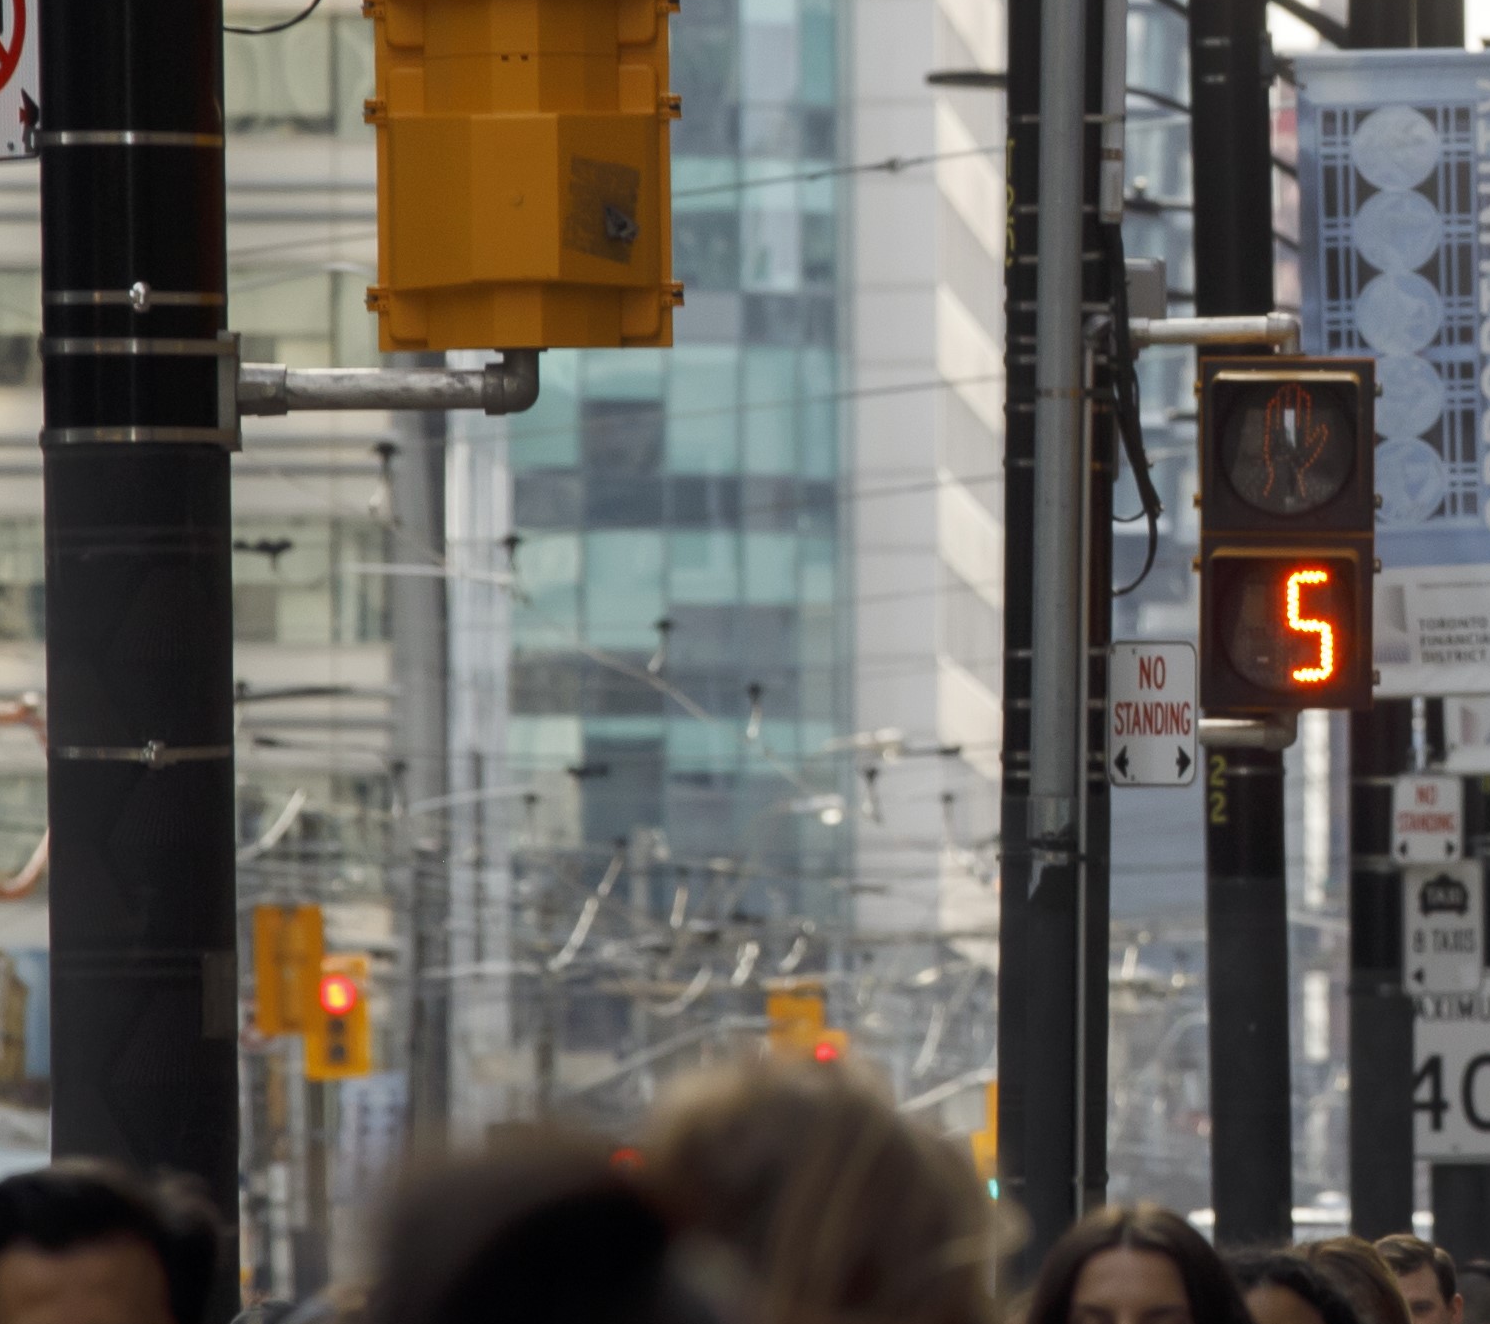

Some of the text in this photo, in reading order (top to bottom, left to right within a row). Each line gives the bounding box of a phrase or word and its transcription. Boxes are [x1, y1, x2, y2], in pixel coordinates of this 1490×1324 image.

[1284, 569, 1336, 683] 5
[1139, 655, 1166, 690] NO
[1114, 701, 1191, 736] STANDING
[1415, 784, 1438, 805] NO
